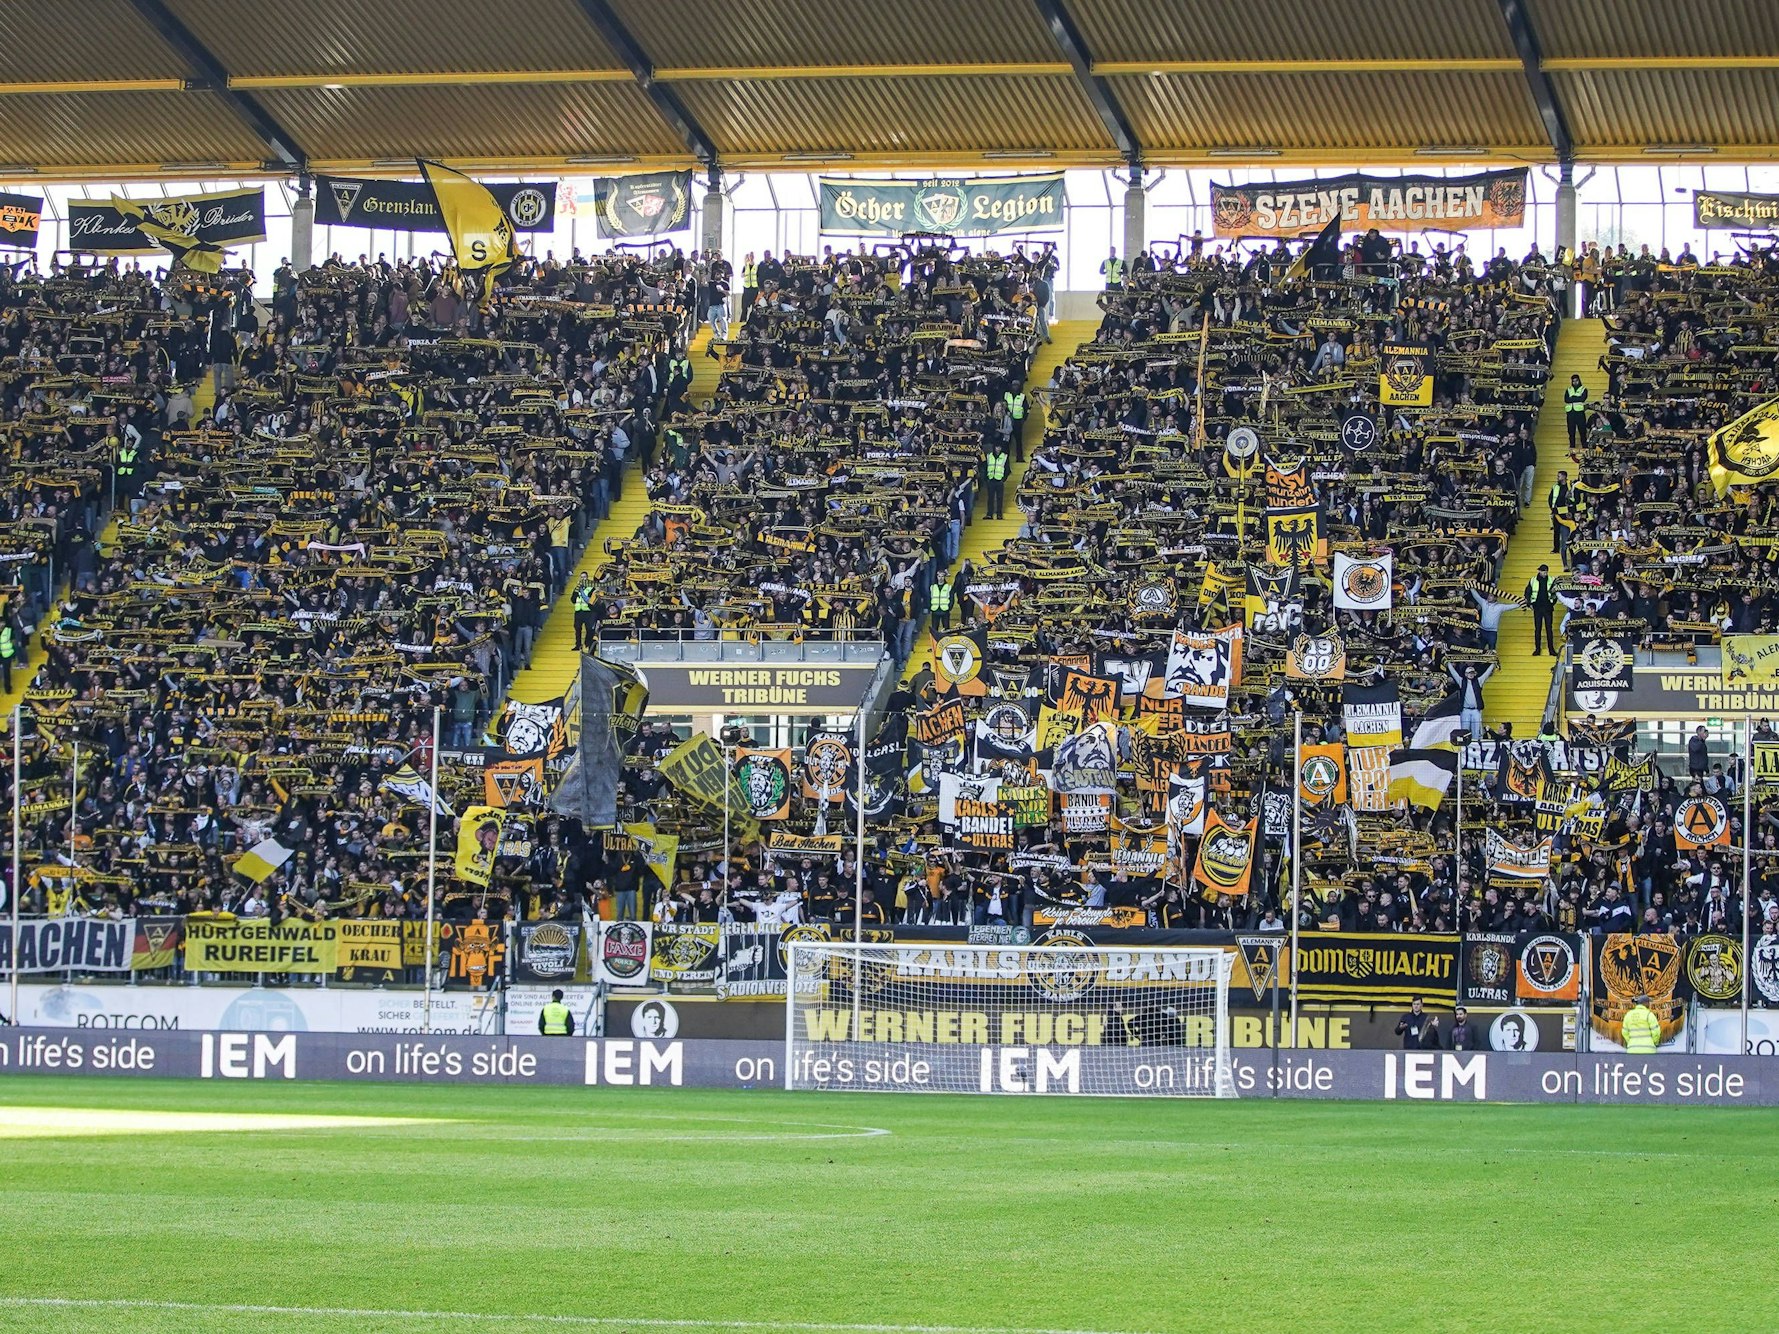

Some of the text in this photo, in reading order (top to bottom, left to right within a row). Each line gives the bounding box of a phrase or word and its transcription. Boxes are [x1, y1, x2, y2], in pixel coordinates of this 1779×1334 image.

[363, 197, 438, 217] Grenzlan
[835, 191, 1055, 224] Öcher Legion
[1255, 184, 1485, 229] SZENE AACHEN
[1383, 345, 1429, 356] ALEMANNIA
[1389, 393, 1420, 402] AACHEN
[688, 670, 841, 687] WERNER FUCHS
[1577, 680, 1629, 689] AQUISGRANA
[721, 686, 807, 703] TRIBÜNE
[1141, 699, 1184, 713] NUR
[1345, 702, 1400, 718] ALEMANNIA
[1353, 720, 1390, 734] AACHEN
[188, 923, 337, 941] HÜRTGENWALD
[342, 923, 400, 939] OECHER
[679, 923, 717, 935] STADT
[1466, 932, 1516, 944] KARLSBANDE
[204, 944, 320, 963] RUREIFEL
[350, 949, 392, 962] KRAU
[606, 939, 643, 957] FAXE
[677, 968, 715, 981] VEREIN
[716, 980, 820, 1000] STADIONVEROTE!
[1467, 987, 1509, 1001] ULTRAS
[413, 1000, 458, 1009] BETELLT.
[77, 1014, 180, 1030] ROTCOM
[378, 1011, 411, 1020] SICHER
[804, 1009, 989, 1043] WERNER
[18, 1035, 155, 1070] life's side
[201, 1033, 297, 1079] IEM
[346, 1042, 537, 1077] on life's side
[585, 1040, 684, 1086] IEM
[736, 1051, 931, 1084] on ife's side
[980, 1047, 1081, 1094] IEM
[1134, 1063, 1174, 1089] on
[1266, 1058, 1334, 1090] side
[1384, 1052, 1487, 1100] IEM
[1541, 1062, 1744, 1097] on life's side
